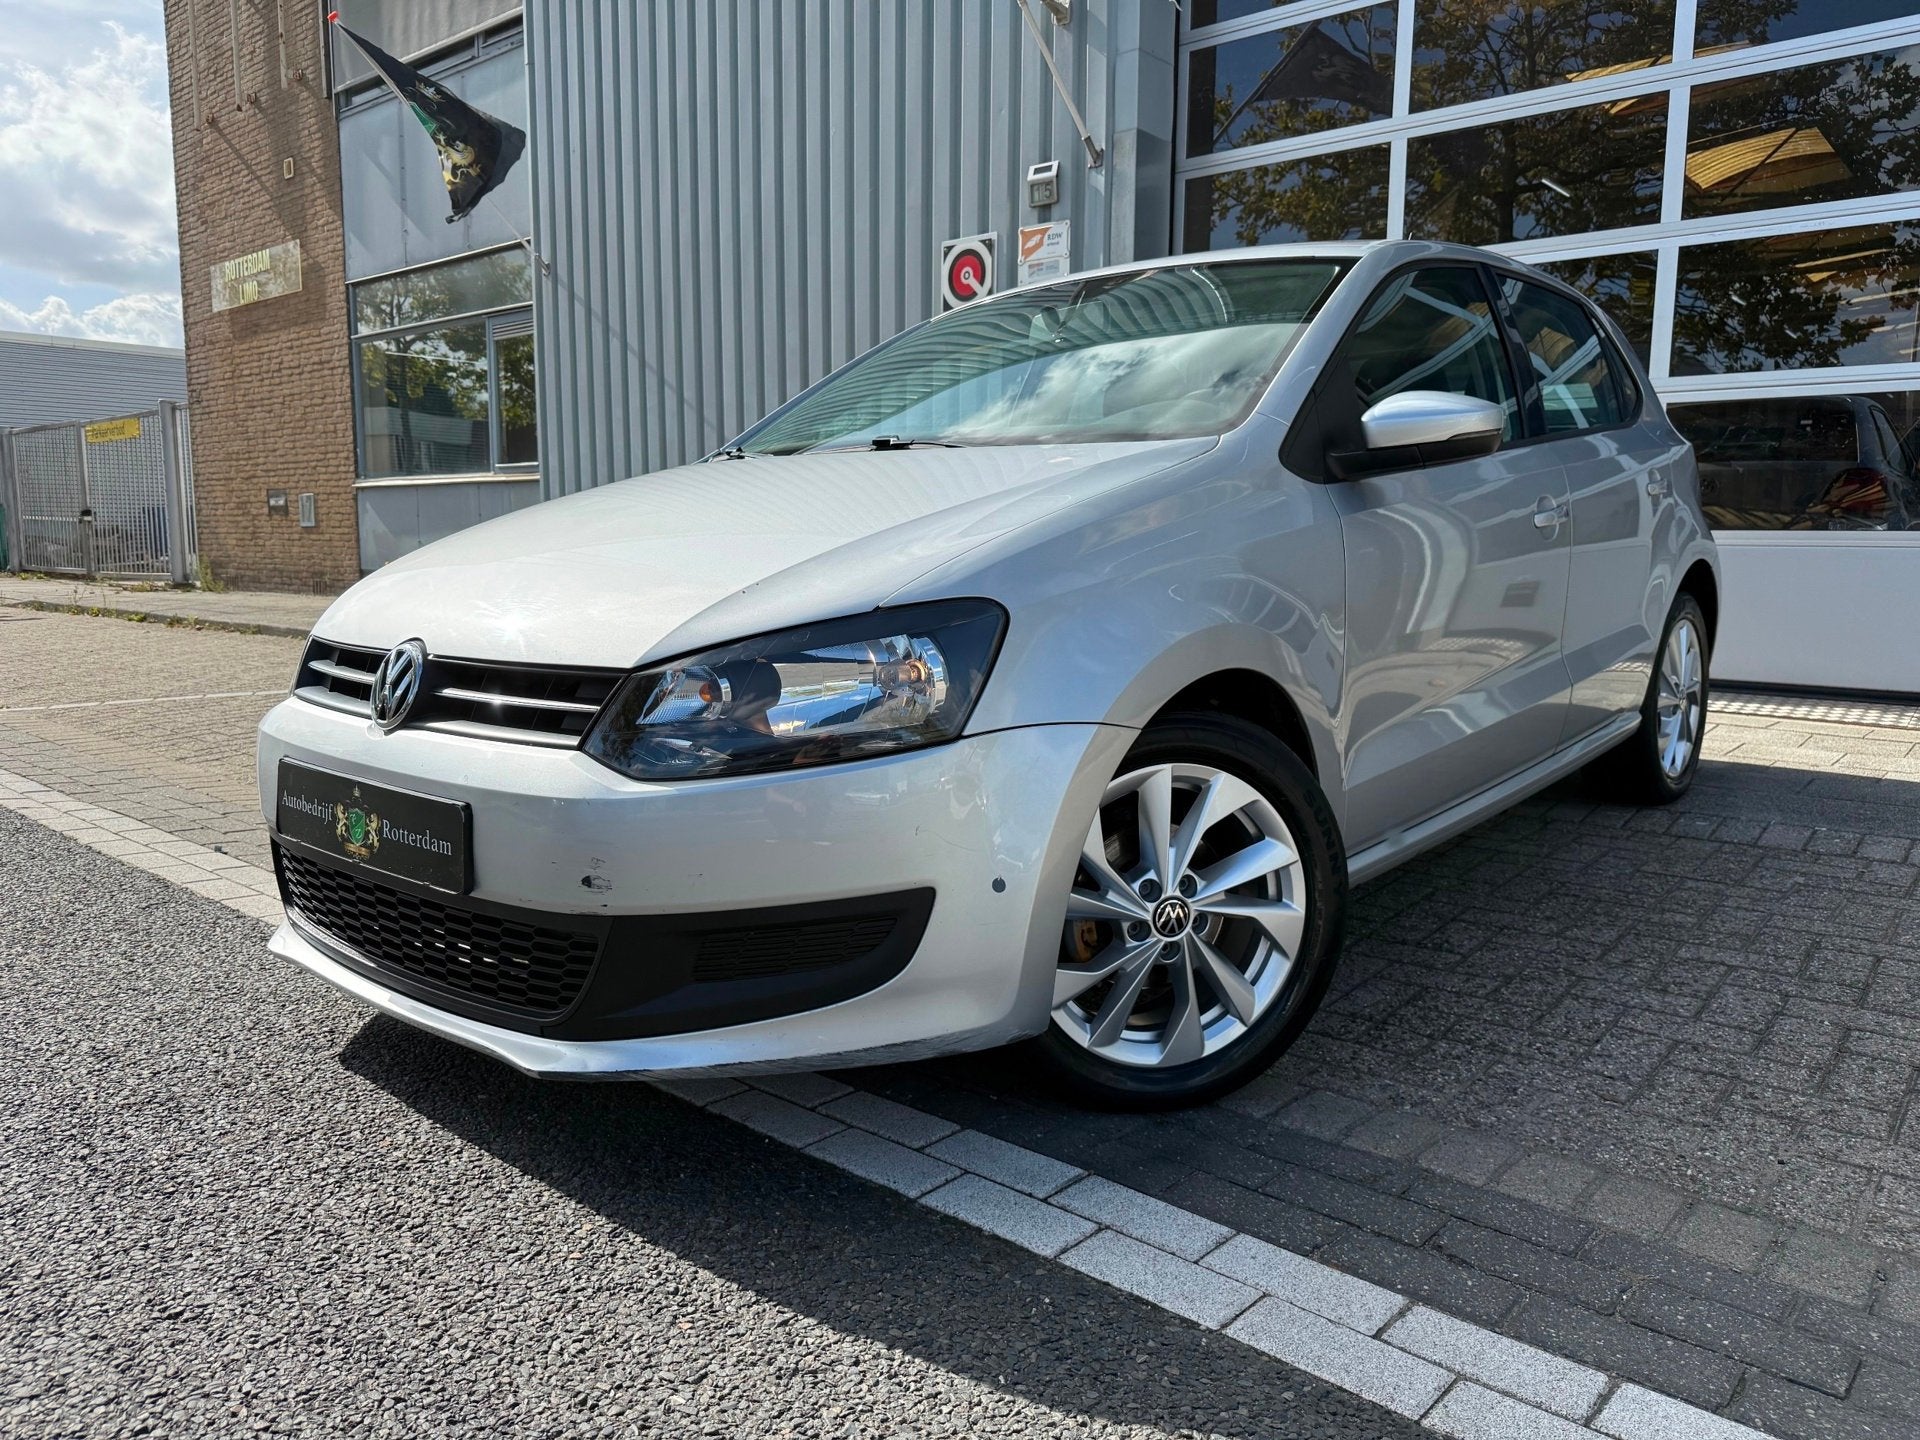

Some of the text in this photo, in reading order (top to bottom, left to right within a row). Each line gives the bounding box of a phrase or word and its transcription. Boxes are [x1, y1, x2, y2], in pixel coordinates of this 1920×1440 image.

[1047, 232, 1063, 241] RDW
[225, 249, 270, 283] ROTTERDAM
[239, 280, 258, 304] LIMO
[281, 789, 334, 825] Autobedrijf
[382, 819, 453, 856] Rotterdam
